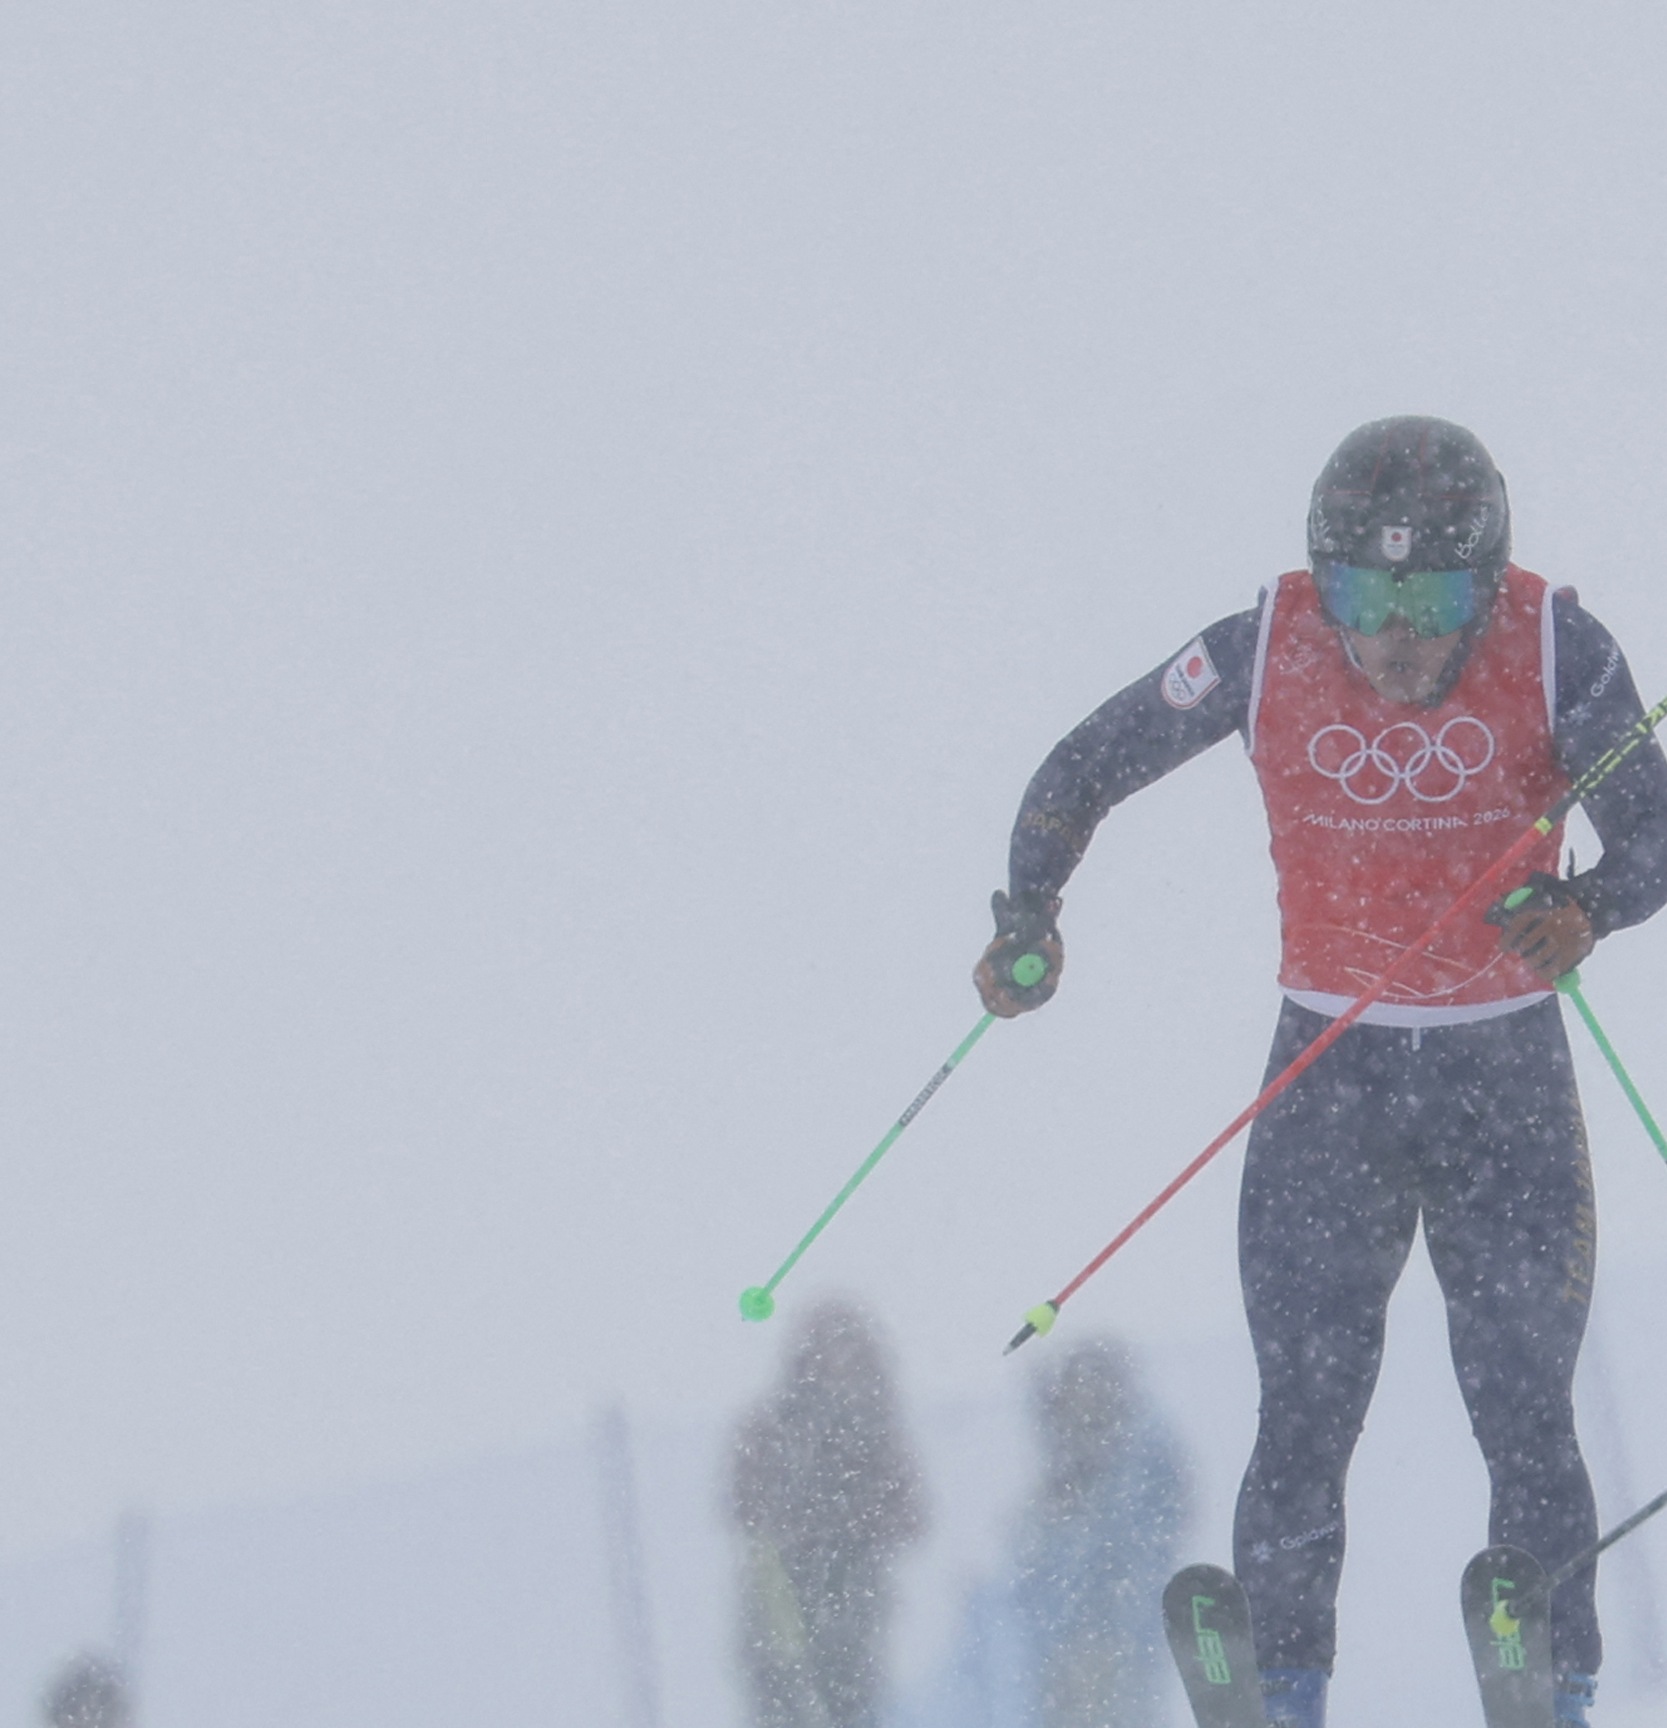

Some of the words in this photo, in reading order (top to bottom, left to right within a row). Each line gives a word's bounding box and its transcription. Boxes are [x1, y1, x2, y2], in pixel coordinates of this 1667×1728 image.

[1302, 813, 1379, 832] MILANO
[1382, 816, 1468, 832] CORTINA
[1473, 808, 1511, 827] 2026
